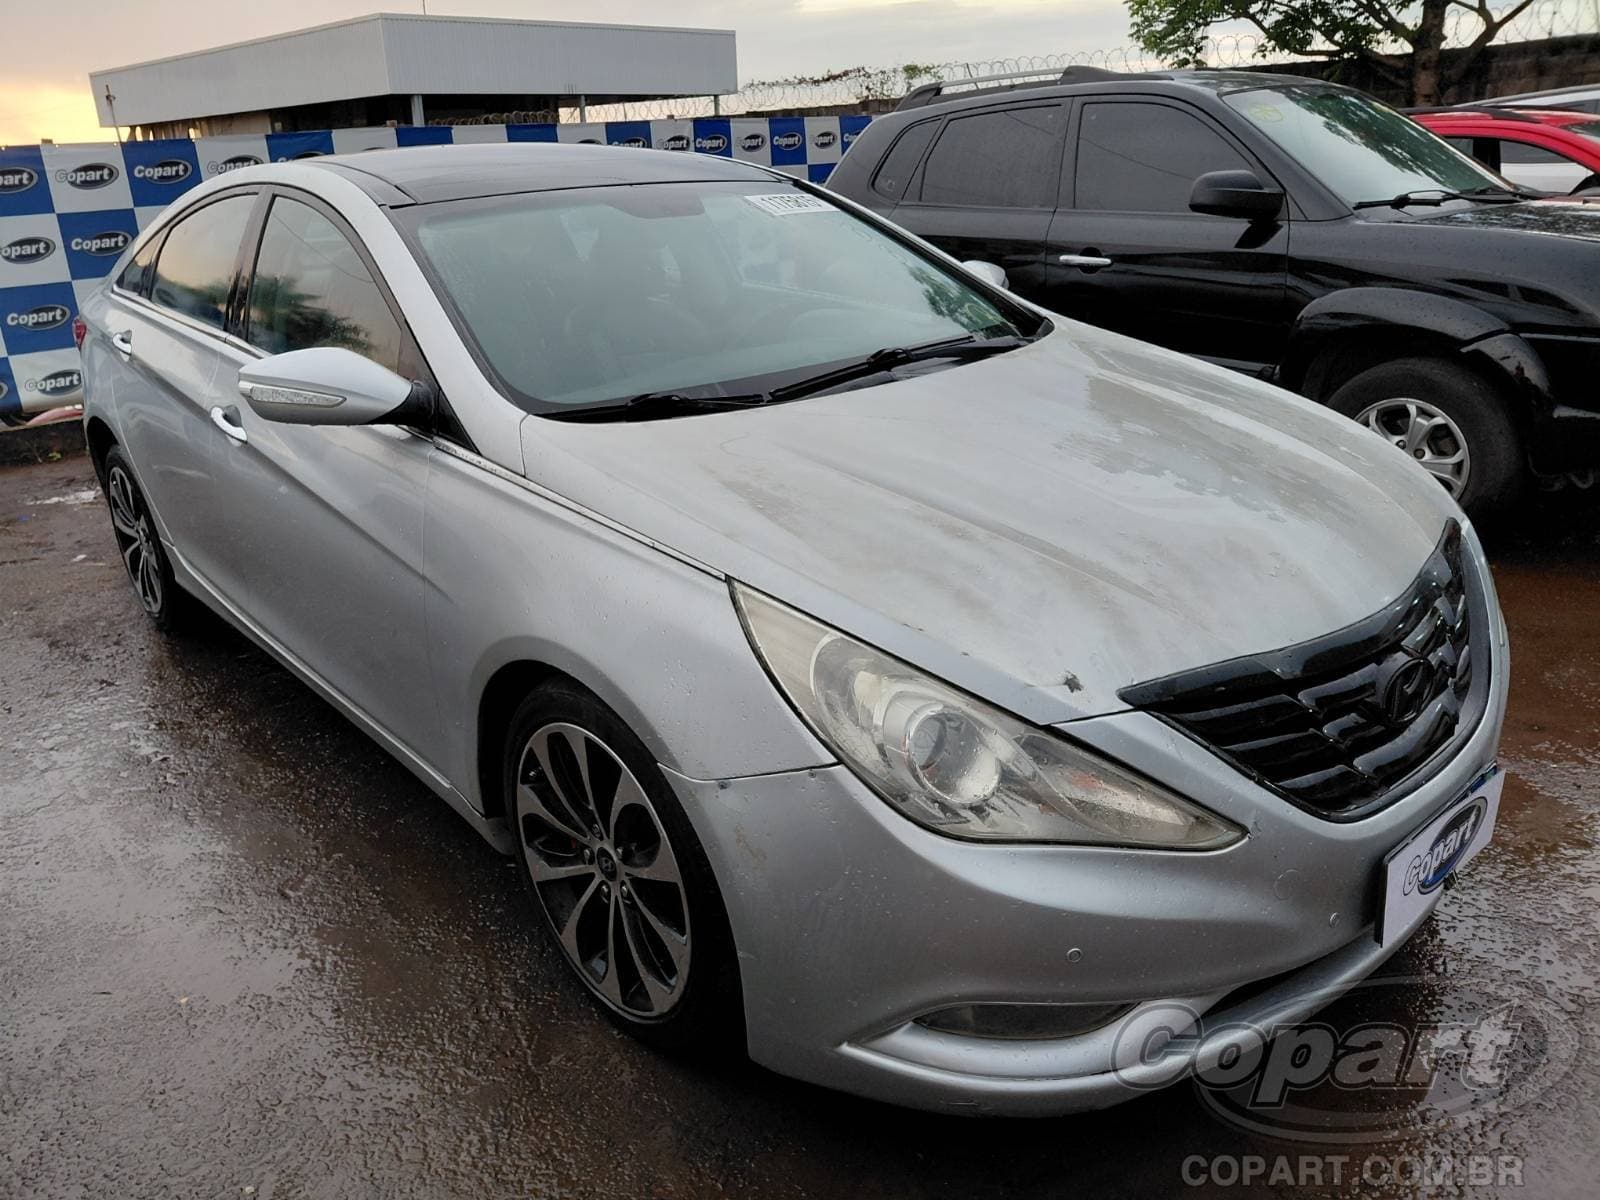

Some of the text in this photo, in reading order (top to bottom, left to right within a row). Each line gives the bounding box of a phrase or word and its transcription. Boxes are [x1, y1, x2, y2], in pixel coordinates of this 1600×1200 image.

[695, 138, 723, 149] Copart
[773, 135, 799, 147] Copart
[0, 172, 30, 186] art
[55, 168, 111, 184] Copart
[134, 162, 186, 181] Copart
[0, 242, 47, 258] opart
[71, 235, 124, 251] Copart
[7, 309, 62, 326] Copart
[25, 373, 79, 391] Copart
[1403, 804, 1479, 896] Copart
